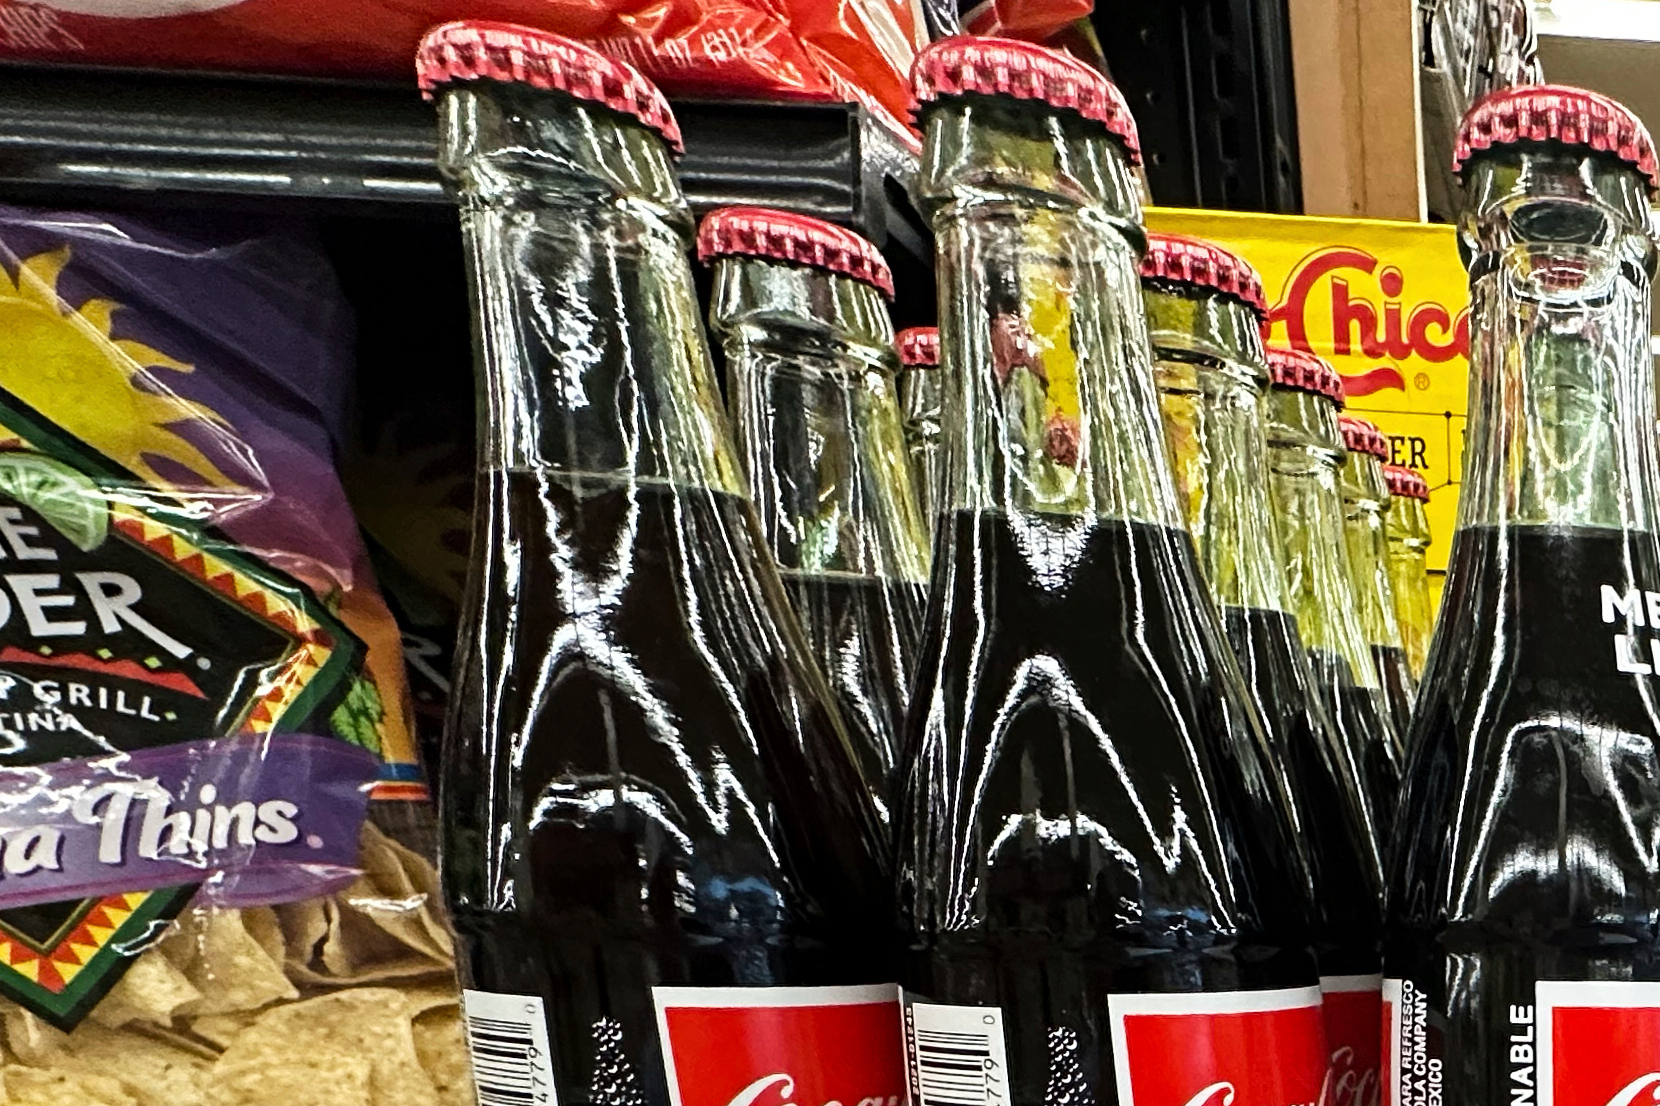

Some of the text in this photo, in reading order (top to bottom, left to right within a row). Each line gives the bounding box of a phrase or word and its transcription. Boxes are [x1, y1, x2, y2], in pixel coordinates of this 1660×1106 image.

[33, 680, 160, 722] GRILL
[72, 780, 299, 867] Thins
[1402, 979, 1414, 1073] REFRESCO
[1414, 989, 1428, 1074] COMPANY
